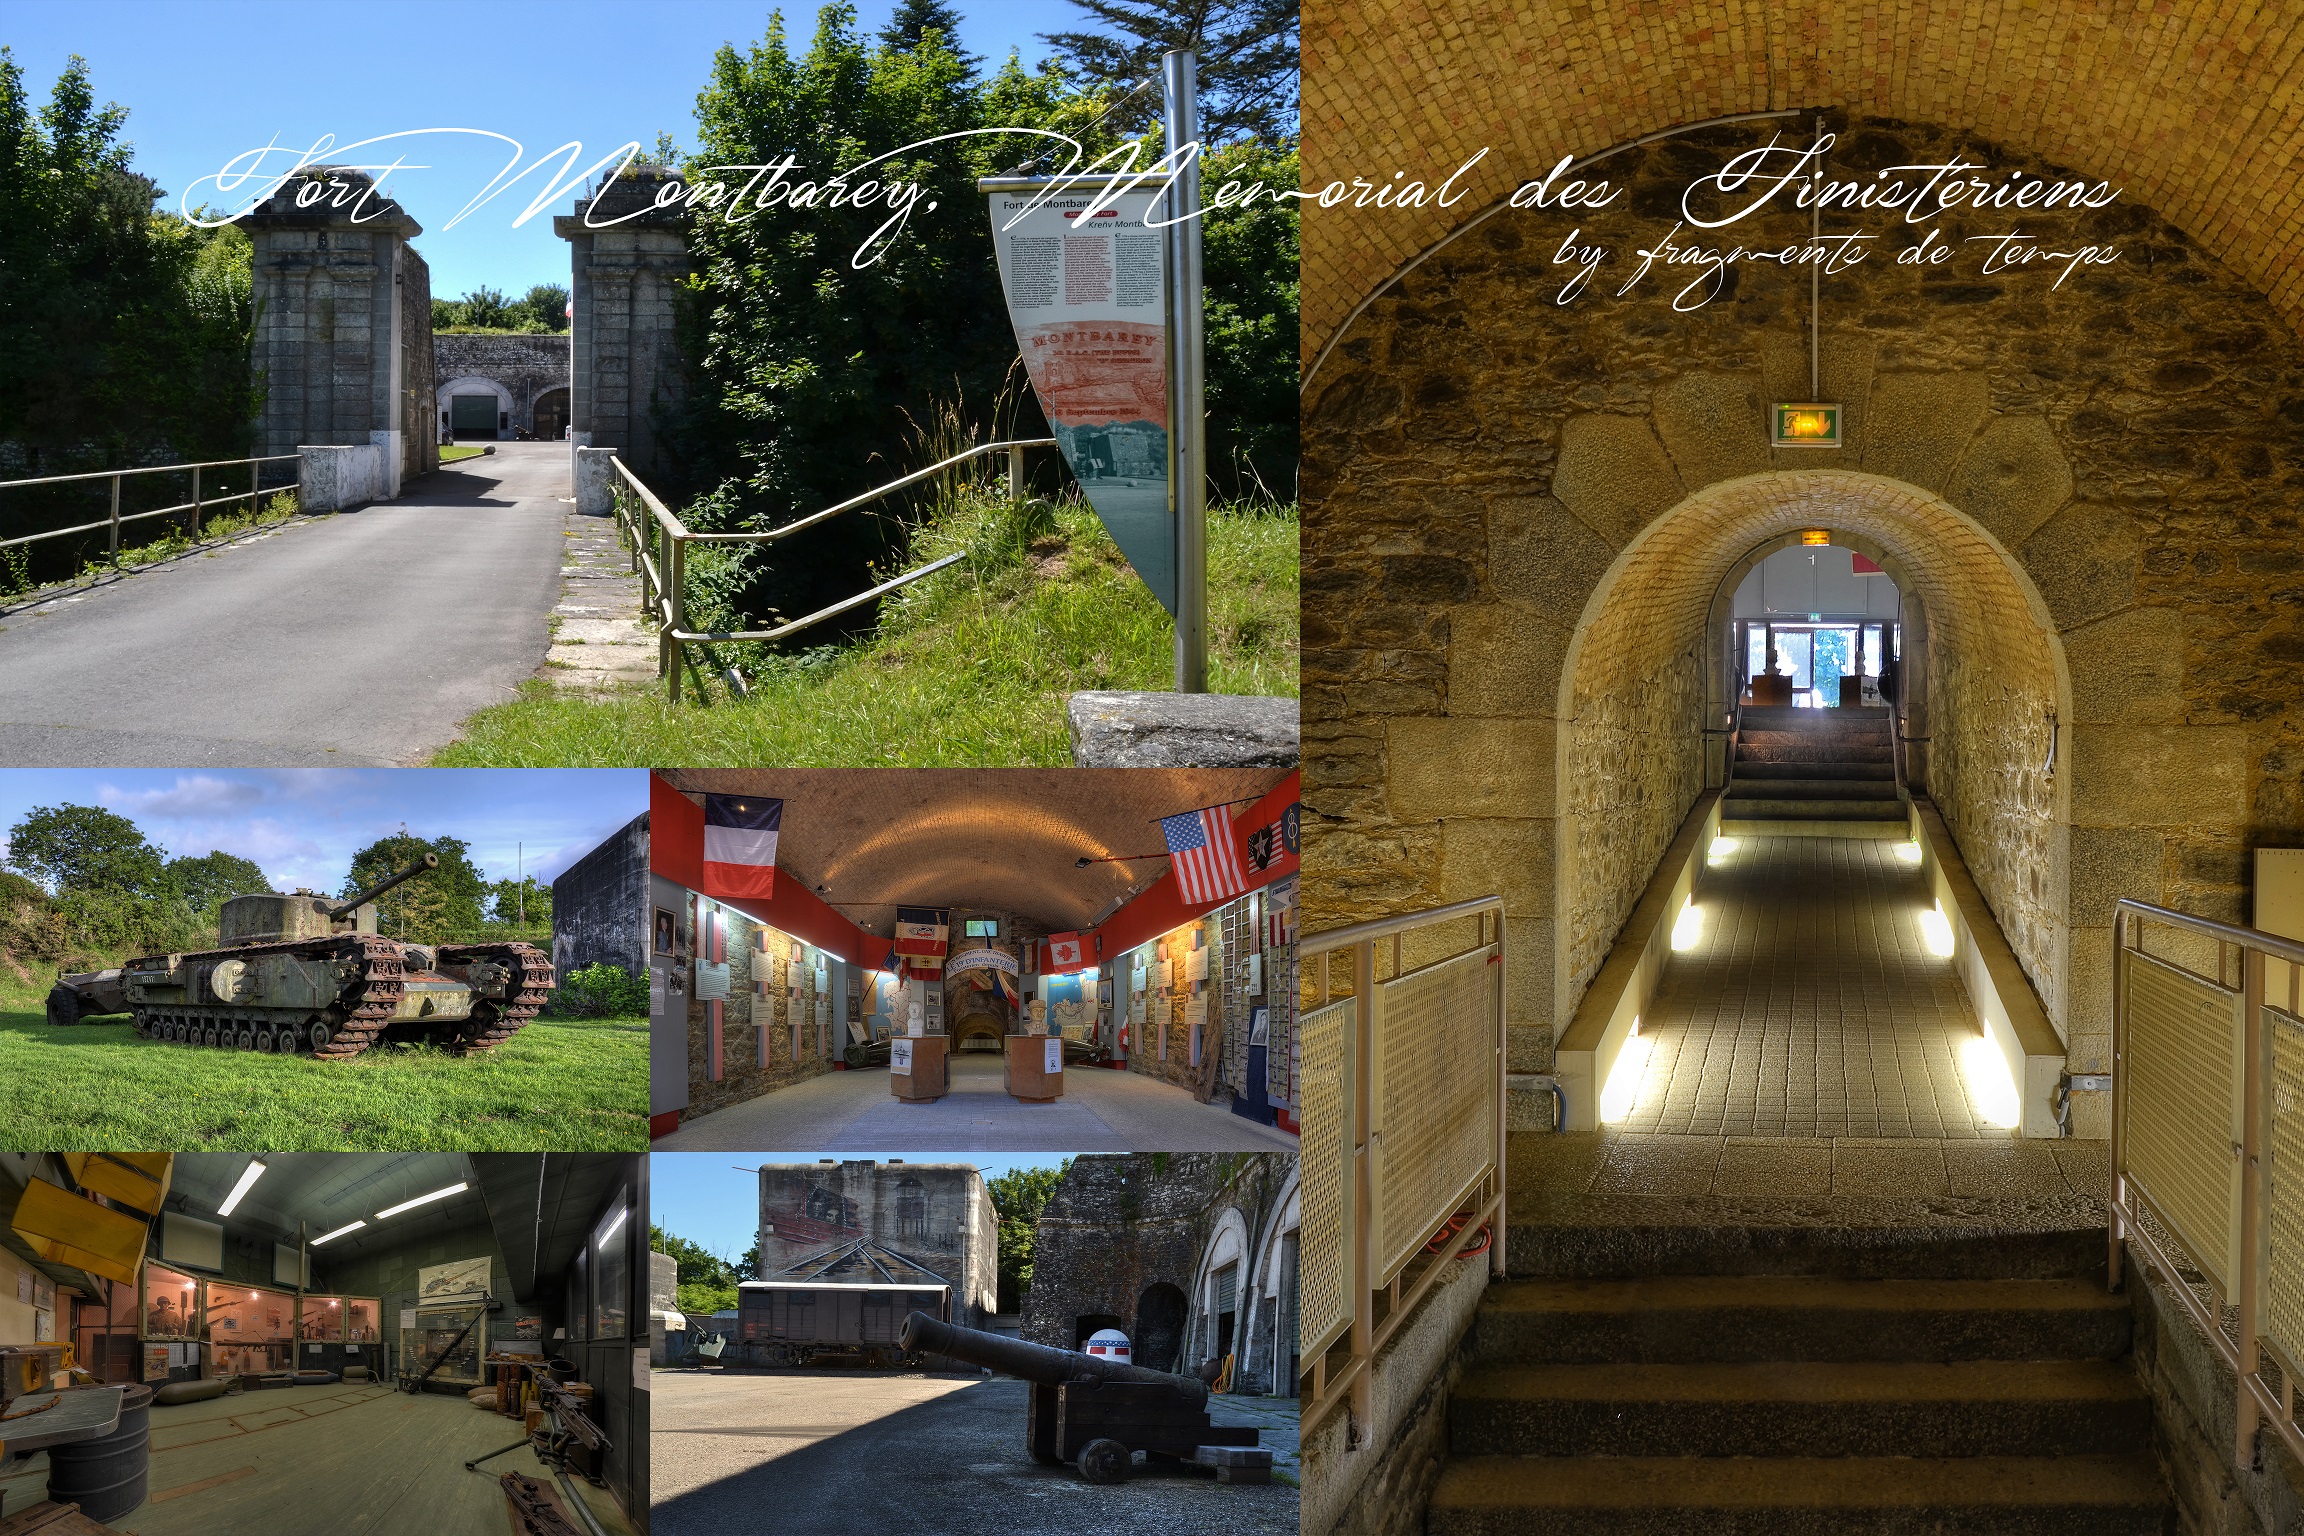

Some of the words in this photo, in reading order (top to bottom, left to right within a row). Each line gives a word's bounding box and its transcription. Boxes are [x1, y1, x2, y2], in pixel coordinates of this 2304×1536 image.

[1004, 202, 1024, 210] Fort
[1089, 221, 1113, 229] Kreñv
[1032, 331, 1157, 347] MONTBAREY
